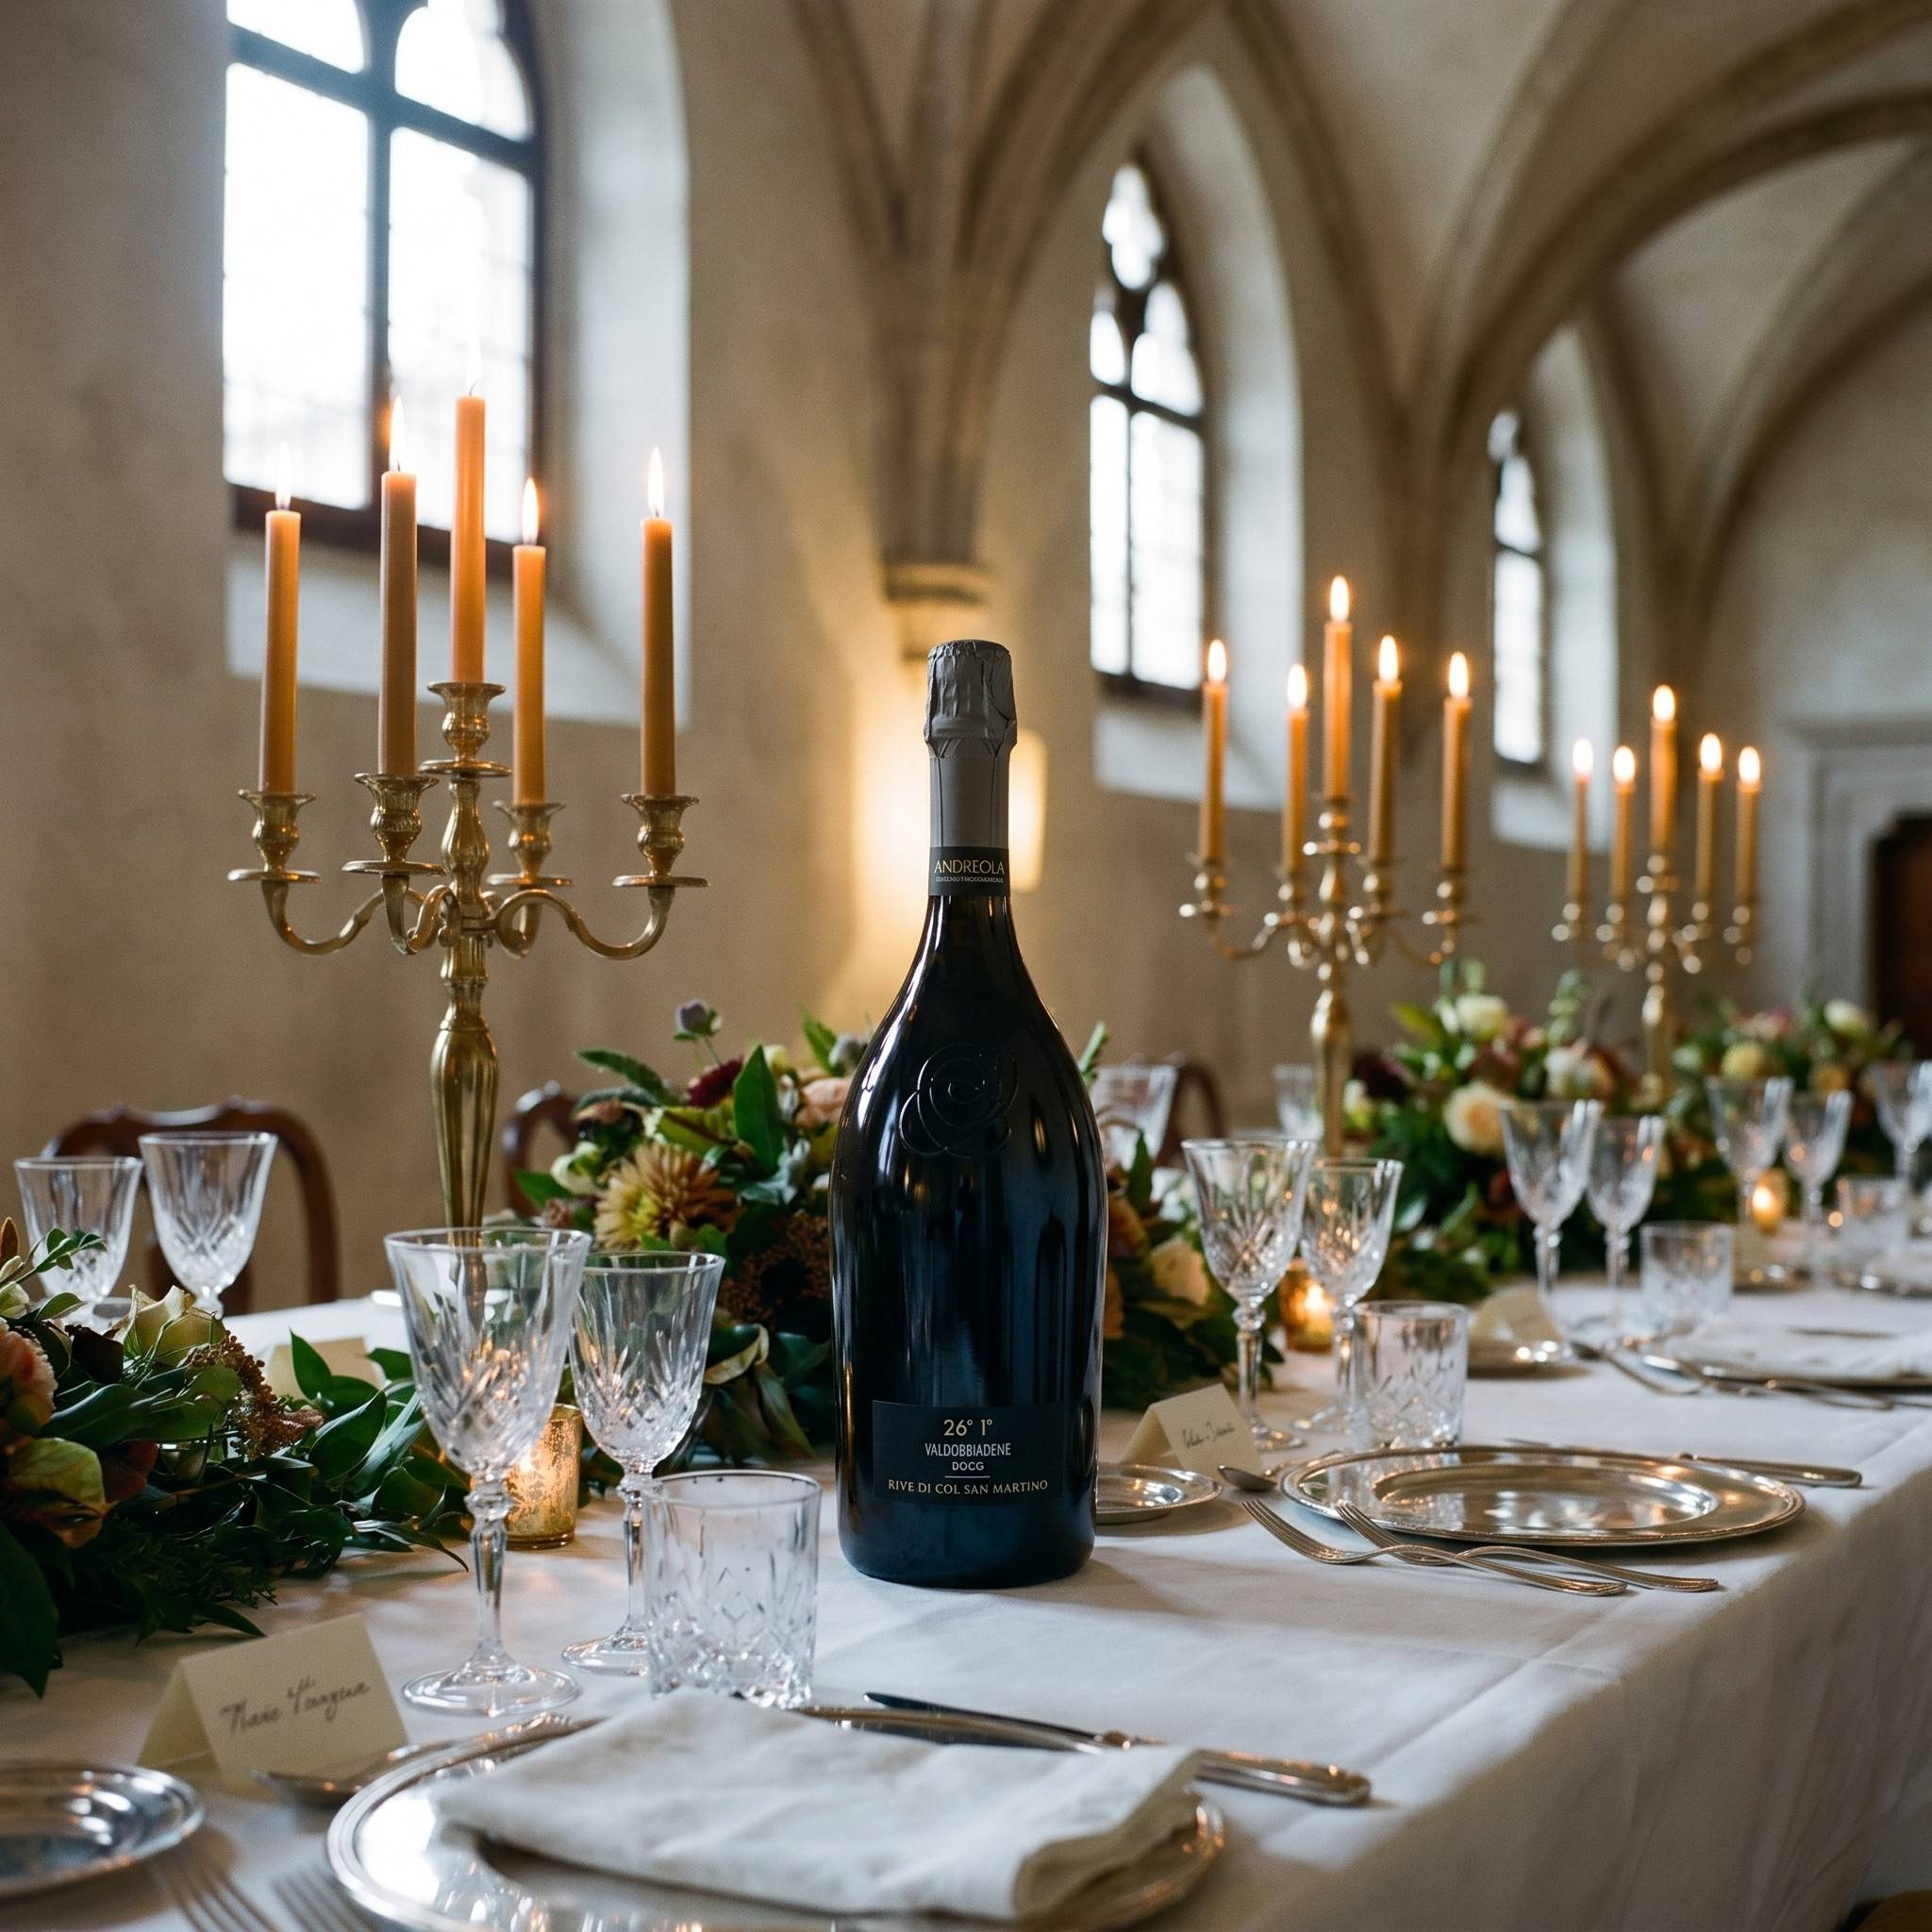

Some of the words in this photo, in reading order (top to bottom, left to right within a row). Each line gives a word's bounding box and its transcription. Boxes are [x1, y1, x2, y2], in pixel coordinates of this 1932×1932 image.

[934, 859, 1005, 874] ANDREOLA
[943, 1419, 974, 1436] 26°
[924, 1442, 1011, 1457] VALDOBBIADENE
[952, 1461, 985, 1472] DOCG
[888, 1478, 915, 1492] RIVE
[918, 1481, 931, 1493] DI
[935, 1483, 961, 1494] COL
[964, 1483, 989, 1494] SAN
[992, 1479, 1048, 1494] MARTINO
